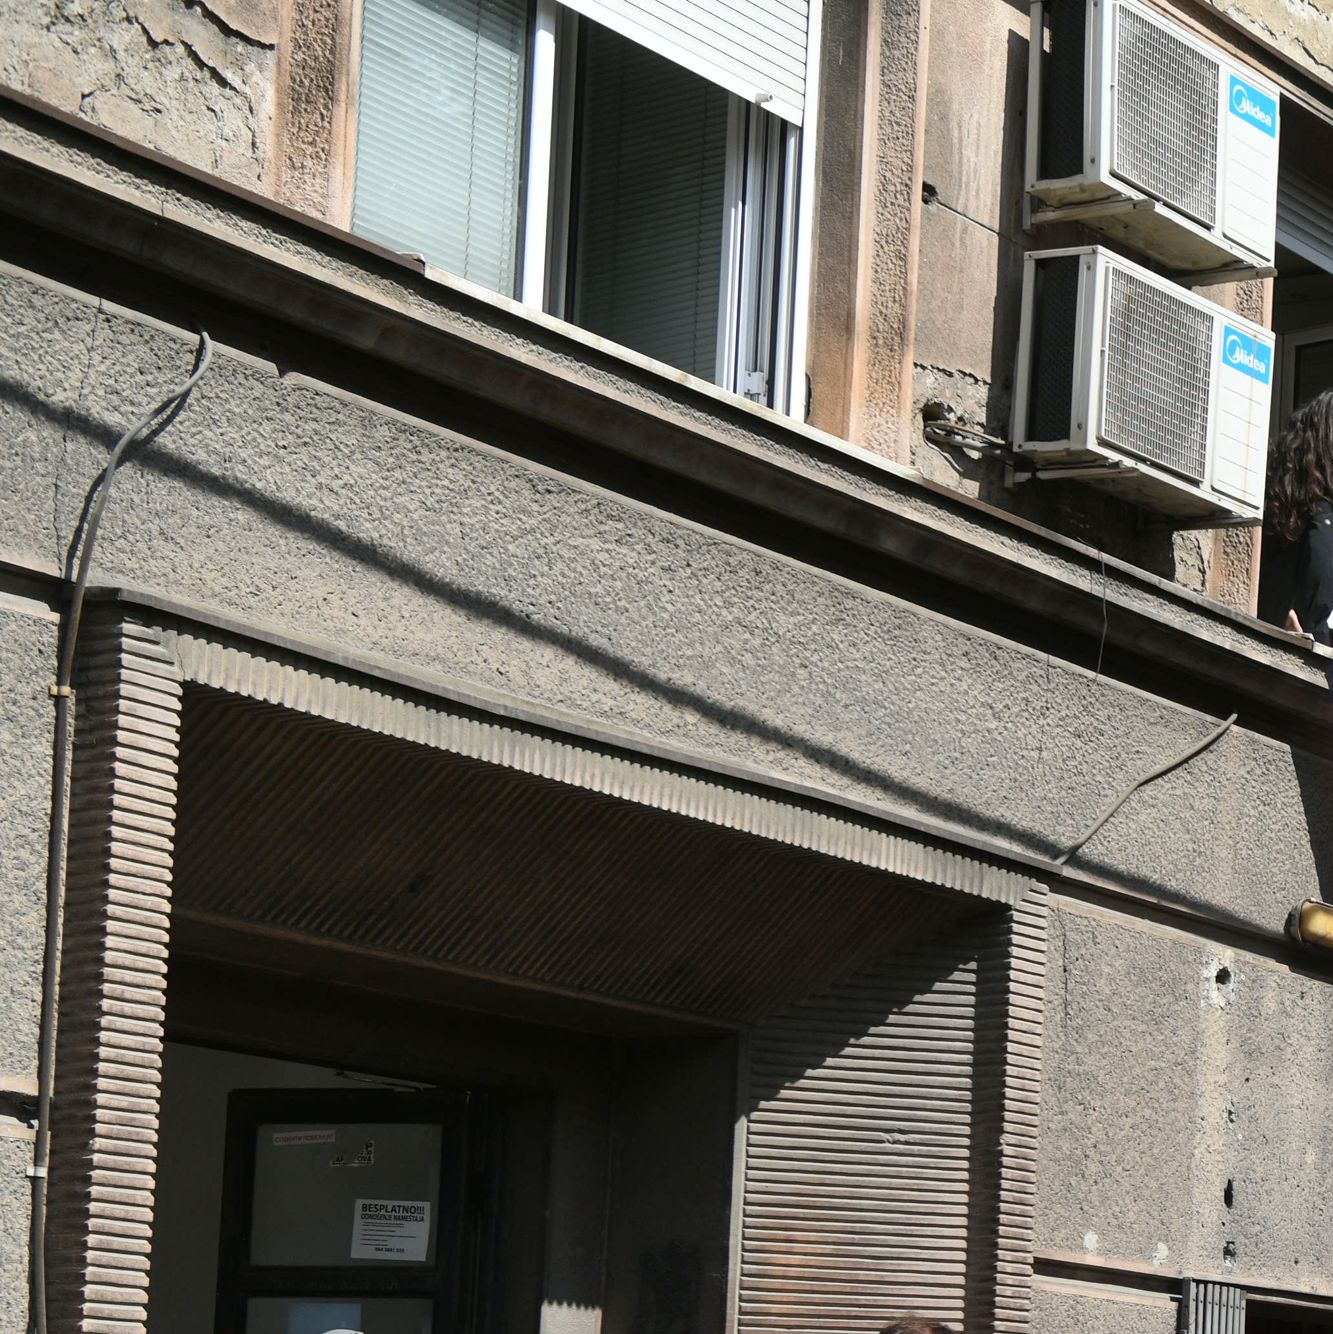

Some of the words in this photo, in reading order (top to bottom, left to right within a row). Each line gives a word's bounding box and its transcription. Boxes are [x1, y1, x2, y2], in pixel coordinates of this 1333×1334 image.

[1233, 85, 1272, 127] Midea
[1226, 335, 1266, 374] Midea
[361, 1203, 425, 1215] BESPLATNO!!!
[393, 1214, 425, 1222] NAMEŠTAJA
